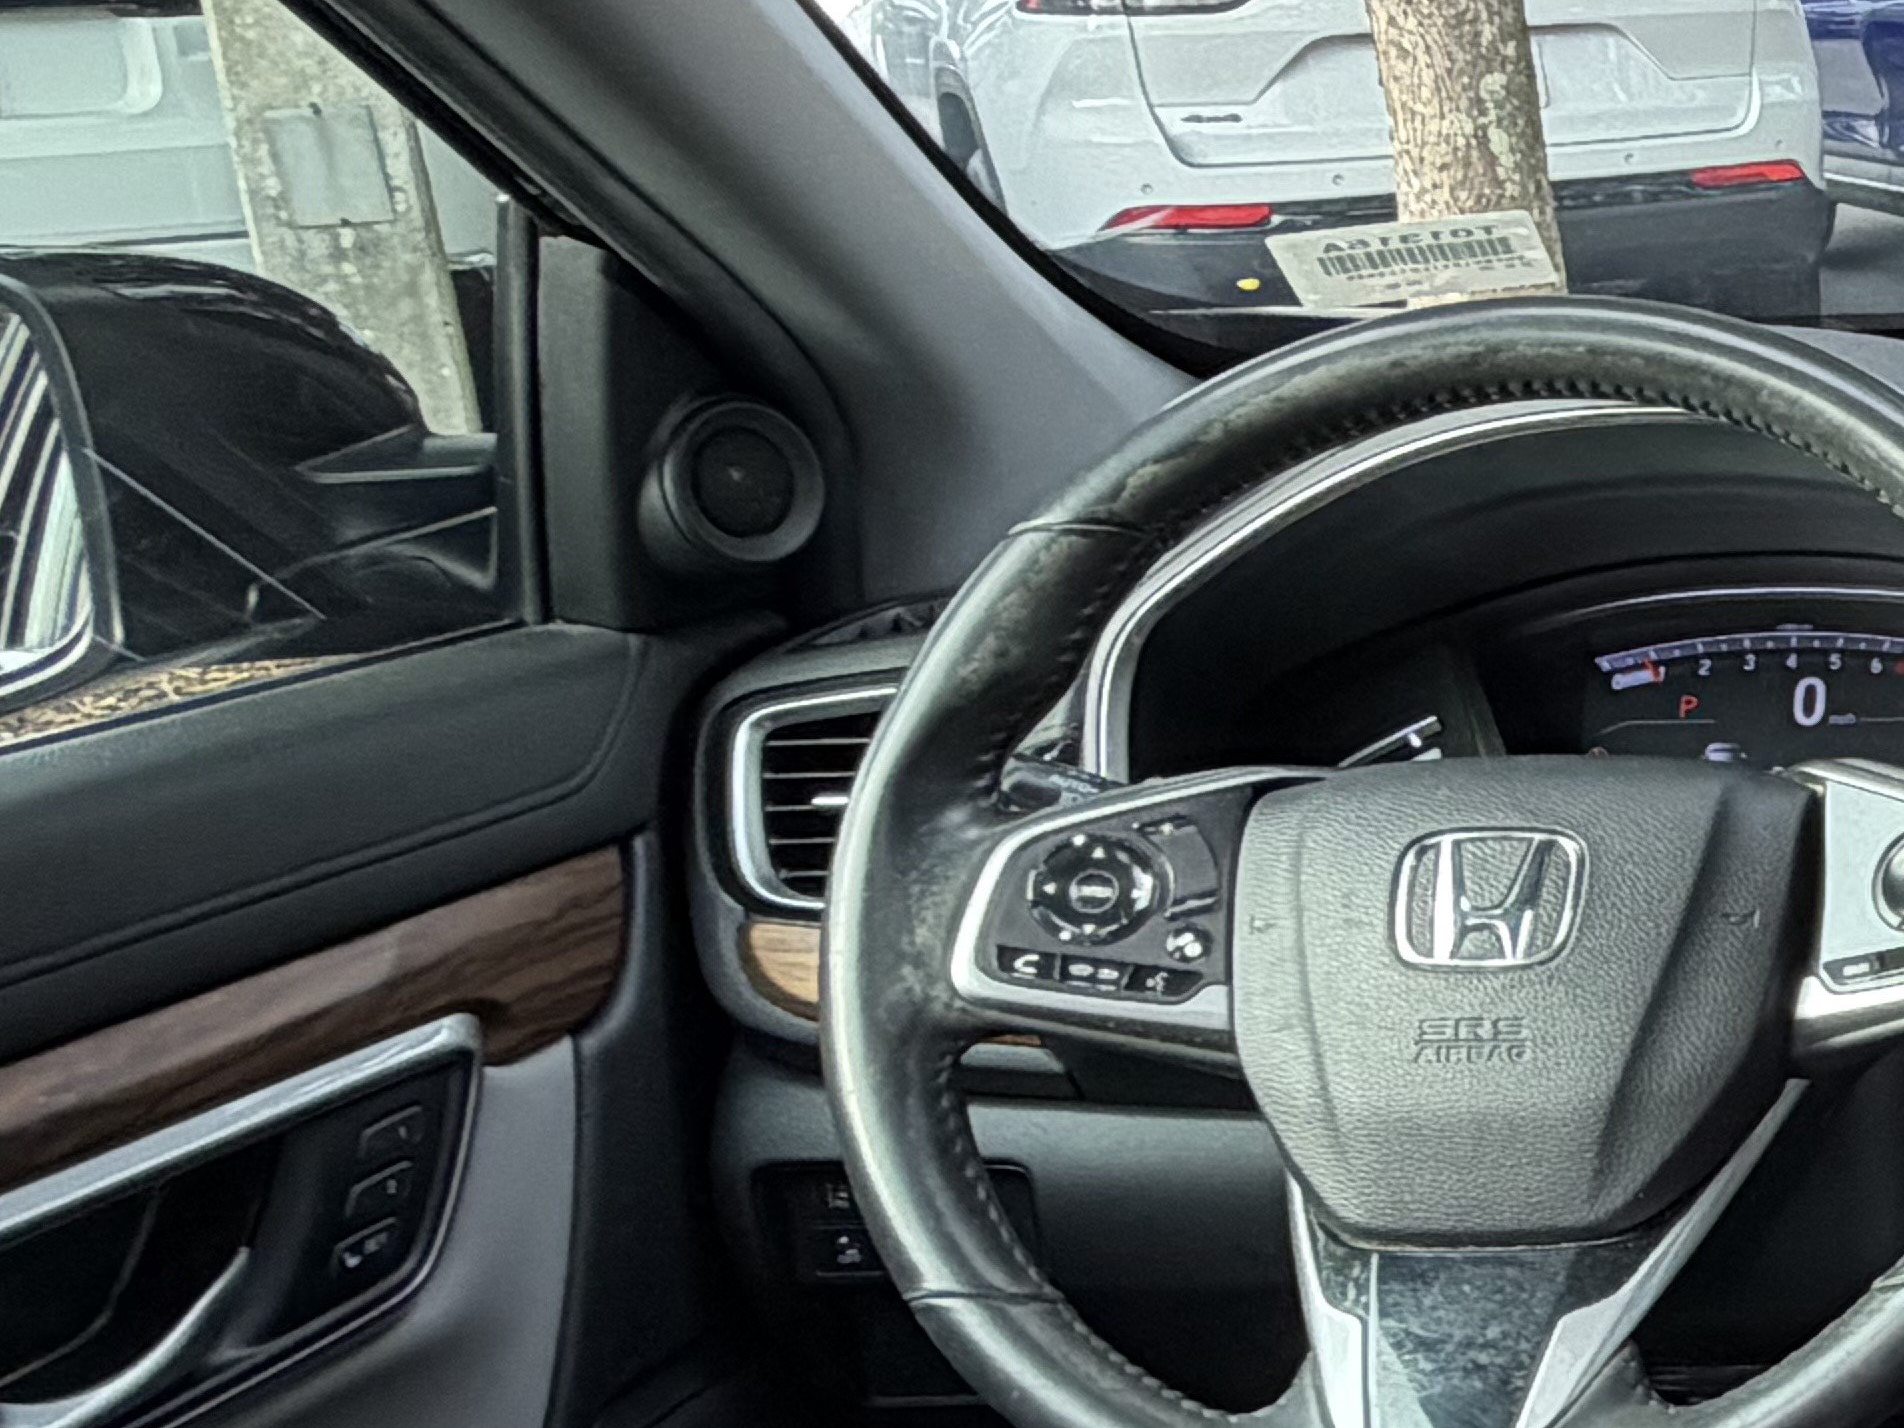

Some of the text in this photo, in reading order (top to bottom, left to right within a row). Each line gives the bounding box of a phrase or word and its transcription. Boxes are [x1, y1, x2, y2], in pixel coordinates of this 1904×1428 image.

[1678, 695, 1699, 718] P
[1792, 675, 1828, 727] 0
[1418, 1016, 1526, 1041] SRS
[1413, 1044, 1528, 1065] AIRBAG
